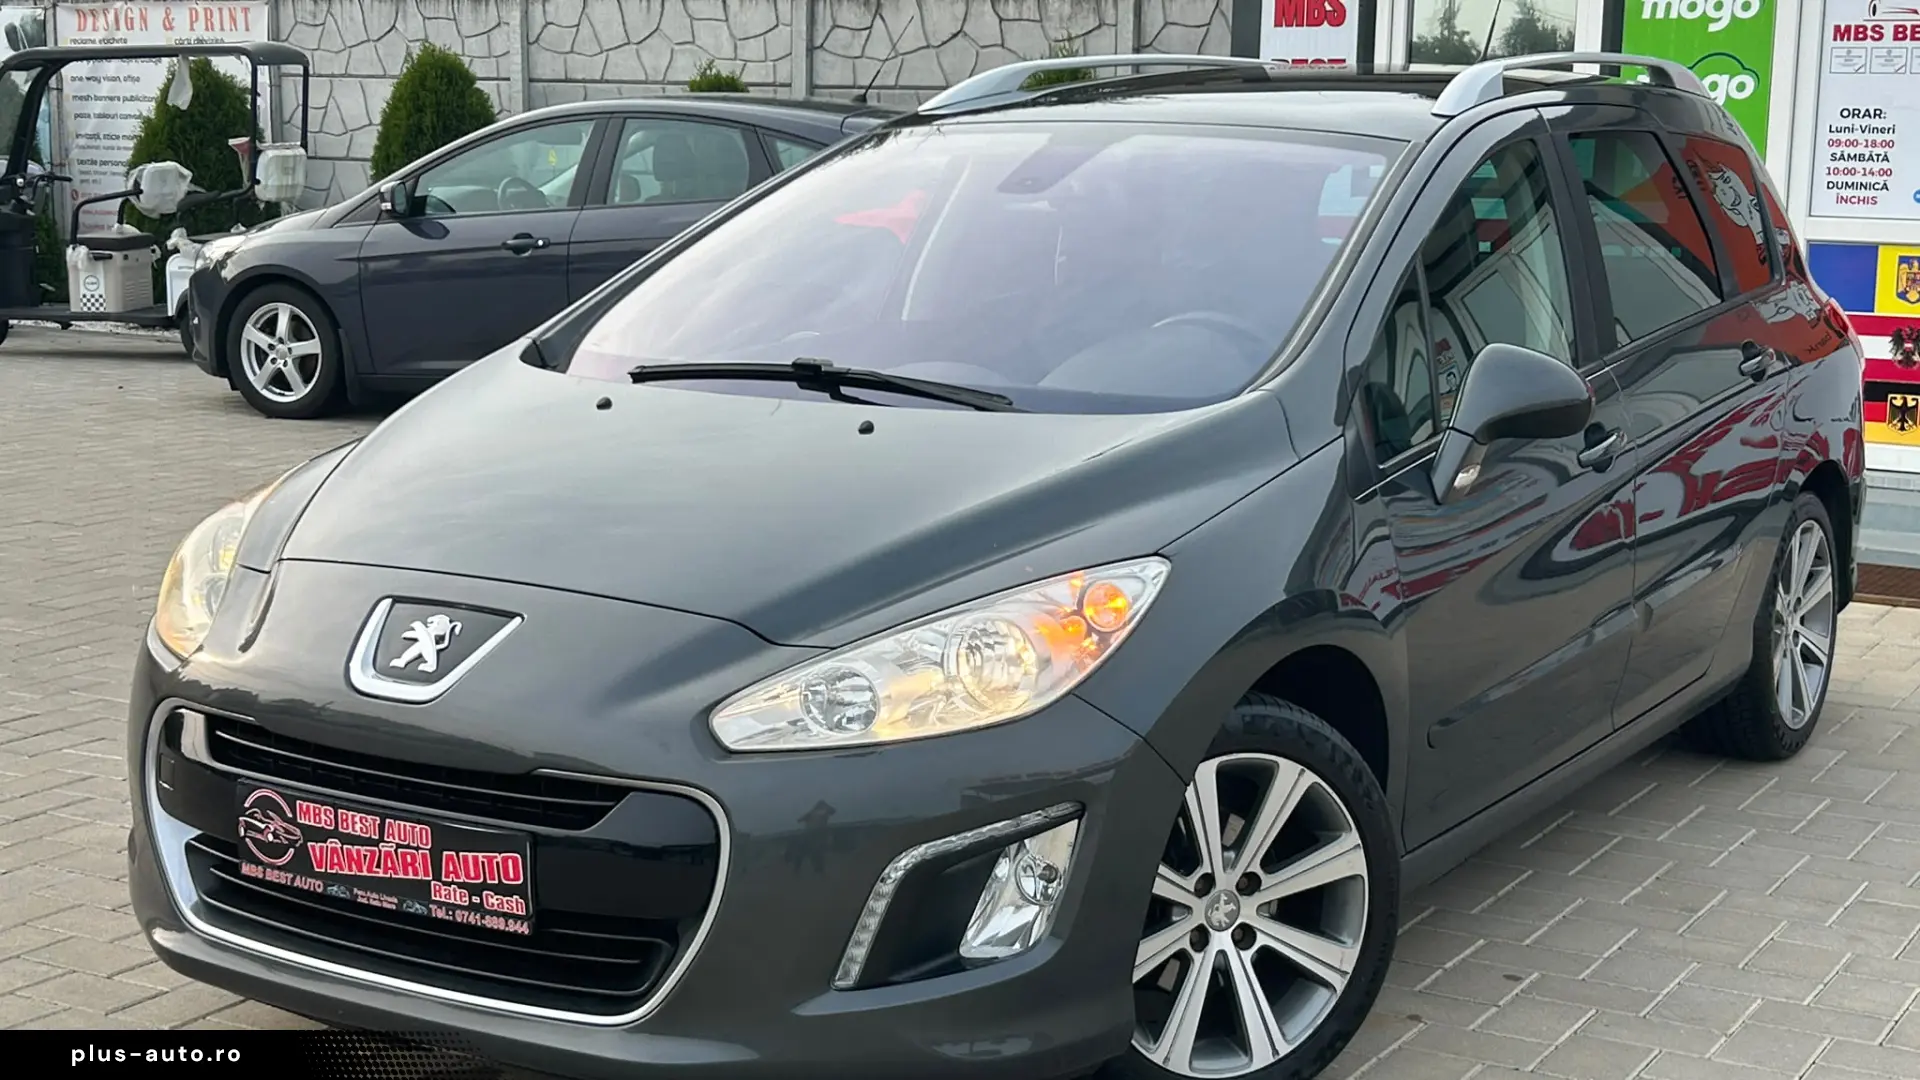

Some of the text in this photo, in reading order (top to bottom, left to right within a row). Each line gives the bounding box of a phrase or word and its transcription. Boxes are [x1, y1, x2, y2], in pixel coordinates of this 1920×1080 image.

[75, 7, 251, 32] DESIGN & PRINT
[1274, 0, 1347, 28] MBS
[1641, 0, 1760, 32] mogo
[1832, 24, 1885, 42] MBS
[85, 75, 102, 84] way
[71, 94, 93, 102] mesh
[1839, 107, 1887, 120] ORAR:
[1828, 123, 1896, 135] Luni-Vineri
[1827, 138, 1895, 149] 09:00-18:00
[76, 158, 98, 166] textile
[1825, 166, 1893, 177] 10:00-14:00
[1826, 179, 1889, 192] DUMINICĂ
[1835, 192, 1878, 206] ÎNCHIS
[296, 800, 432, 850] MBS BEST AUTO
[441, 850, 524, 885] AUTO
[240, 862, 325, 894] MBS BEST AUTO
[430, 880, 527, 916] Rate - Cash
